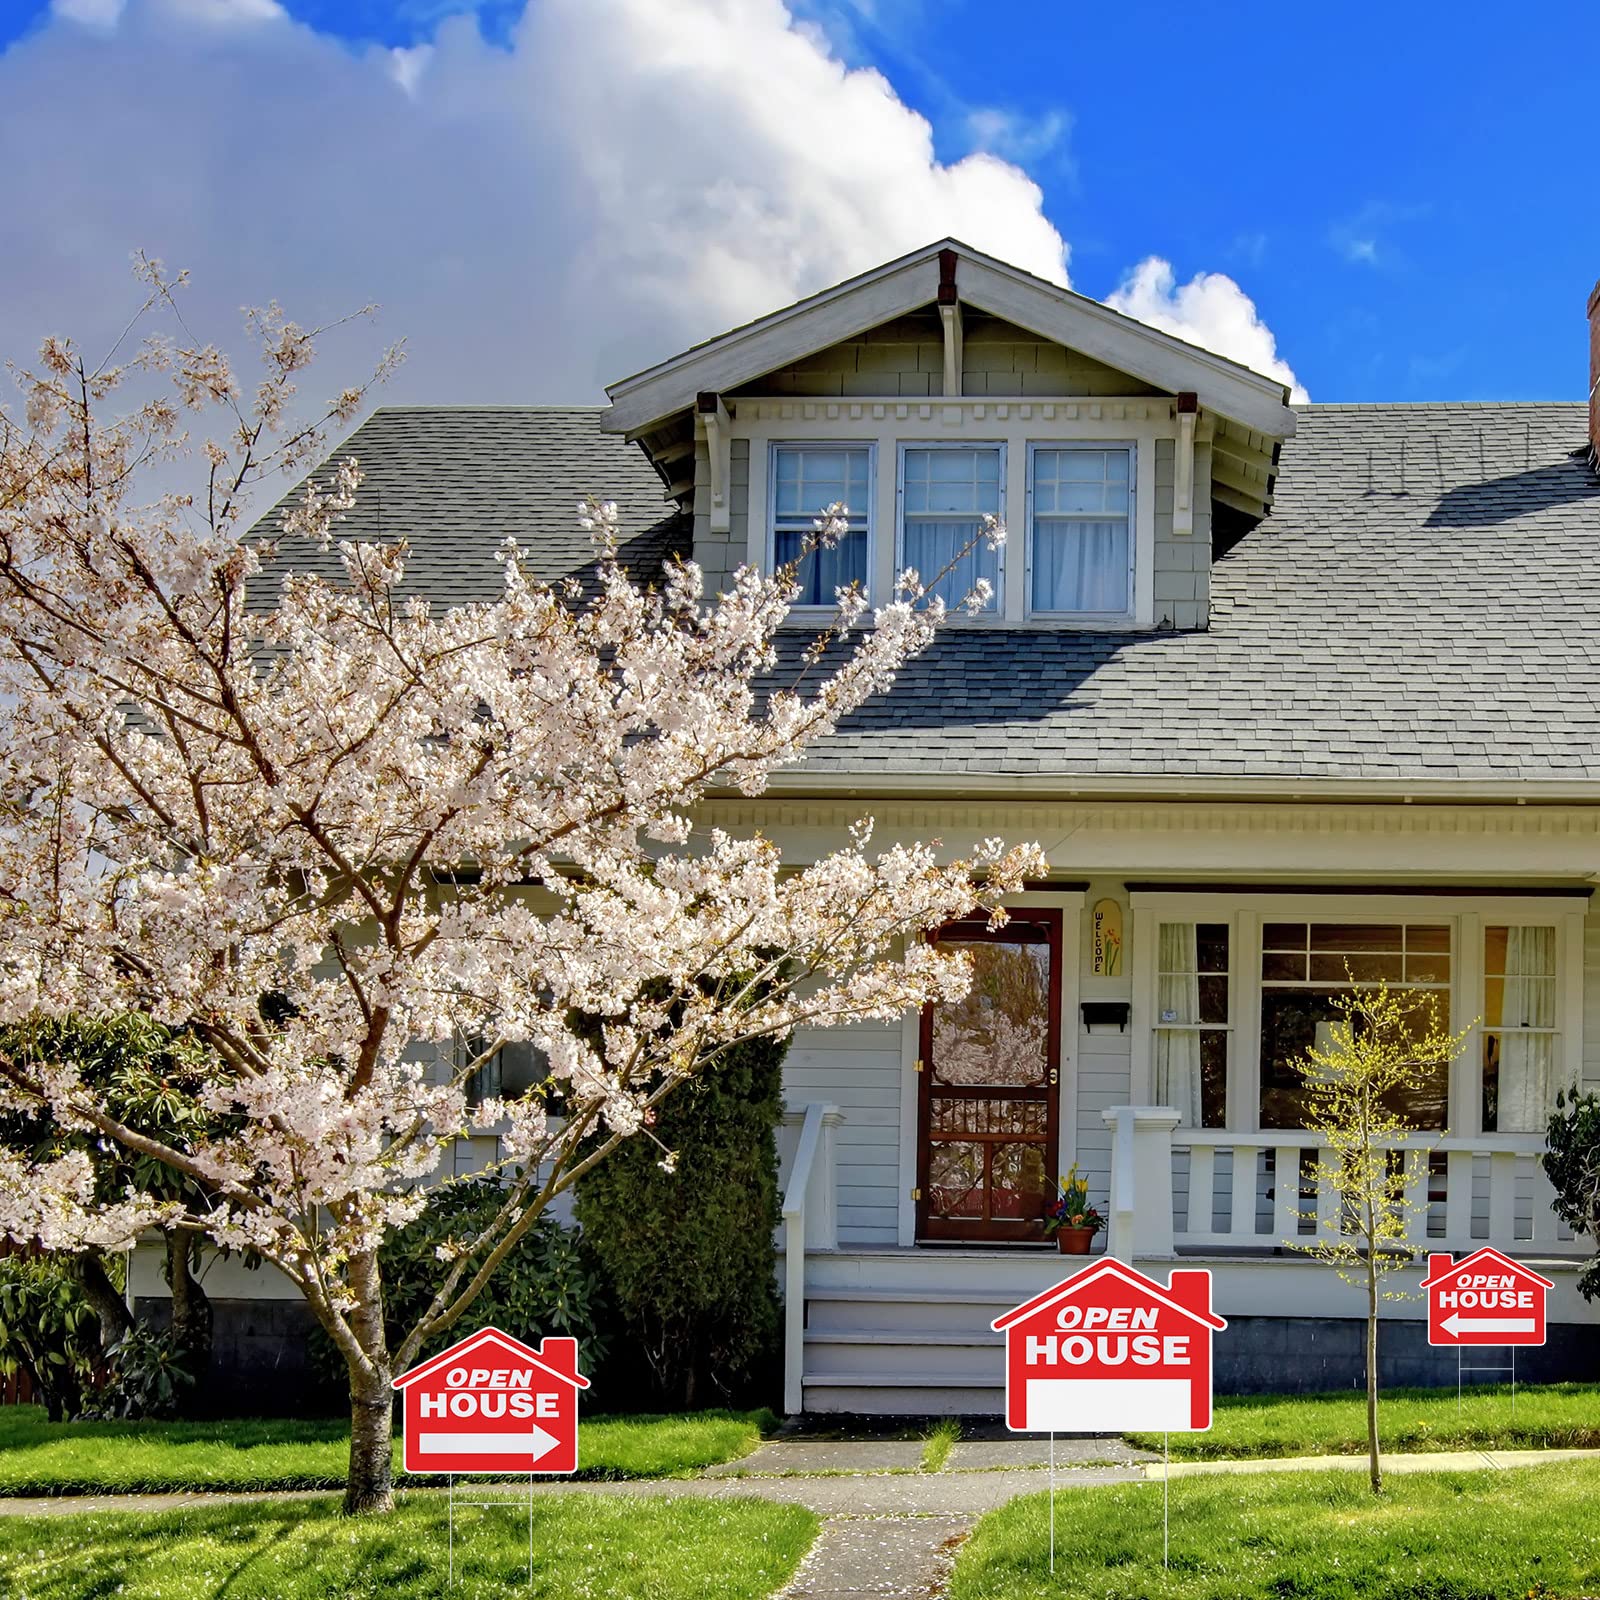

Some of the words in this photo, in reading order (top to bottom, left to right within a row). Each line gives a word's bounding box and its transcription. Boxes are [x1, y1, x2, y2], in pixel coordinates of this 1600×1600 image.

[1094, 912, 1104, 973] WELCOME
[1456, 1274, 1516, 1288] OPEN
[1439, 1291, 1534, 1308] HOUSE
[1056, 1305, 1159, 1329] OPEN
[1025, 1336, 1191, 1365] HOUSE
[445, 1367, 533, 1387] OPEN
[420, 1393, 560, 1418] HOUSE
